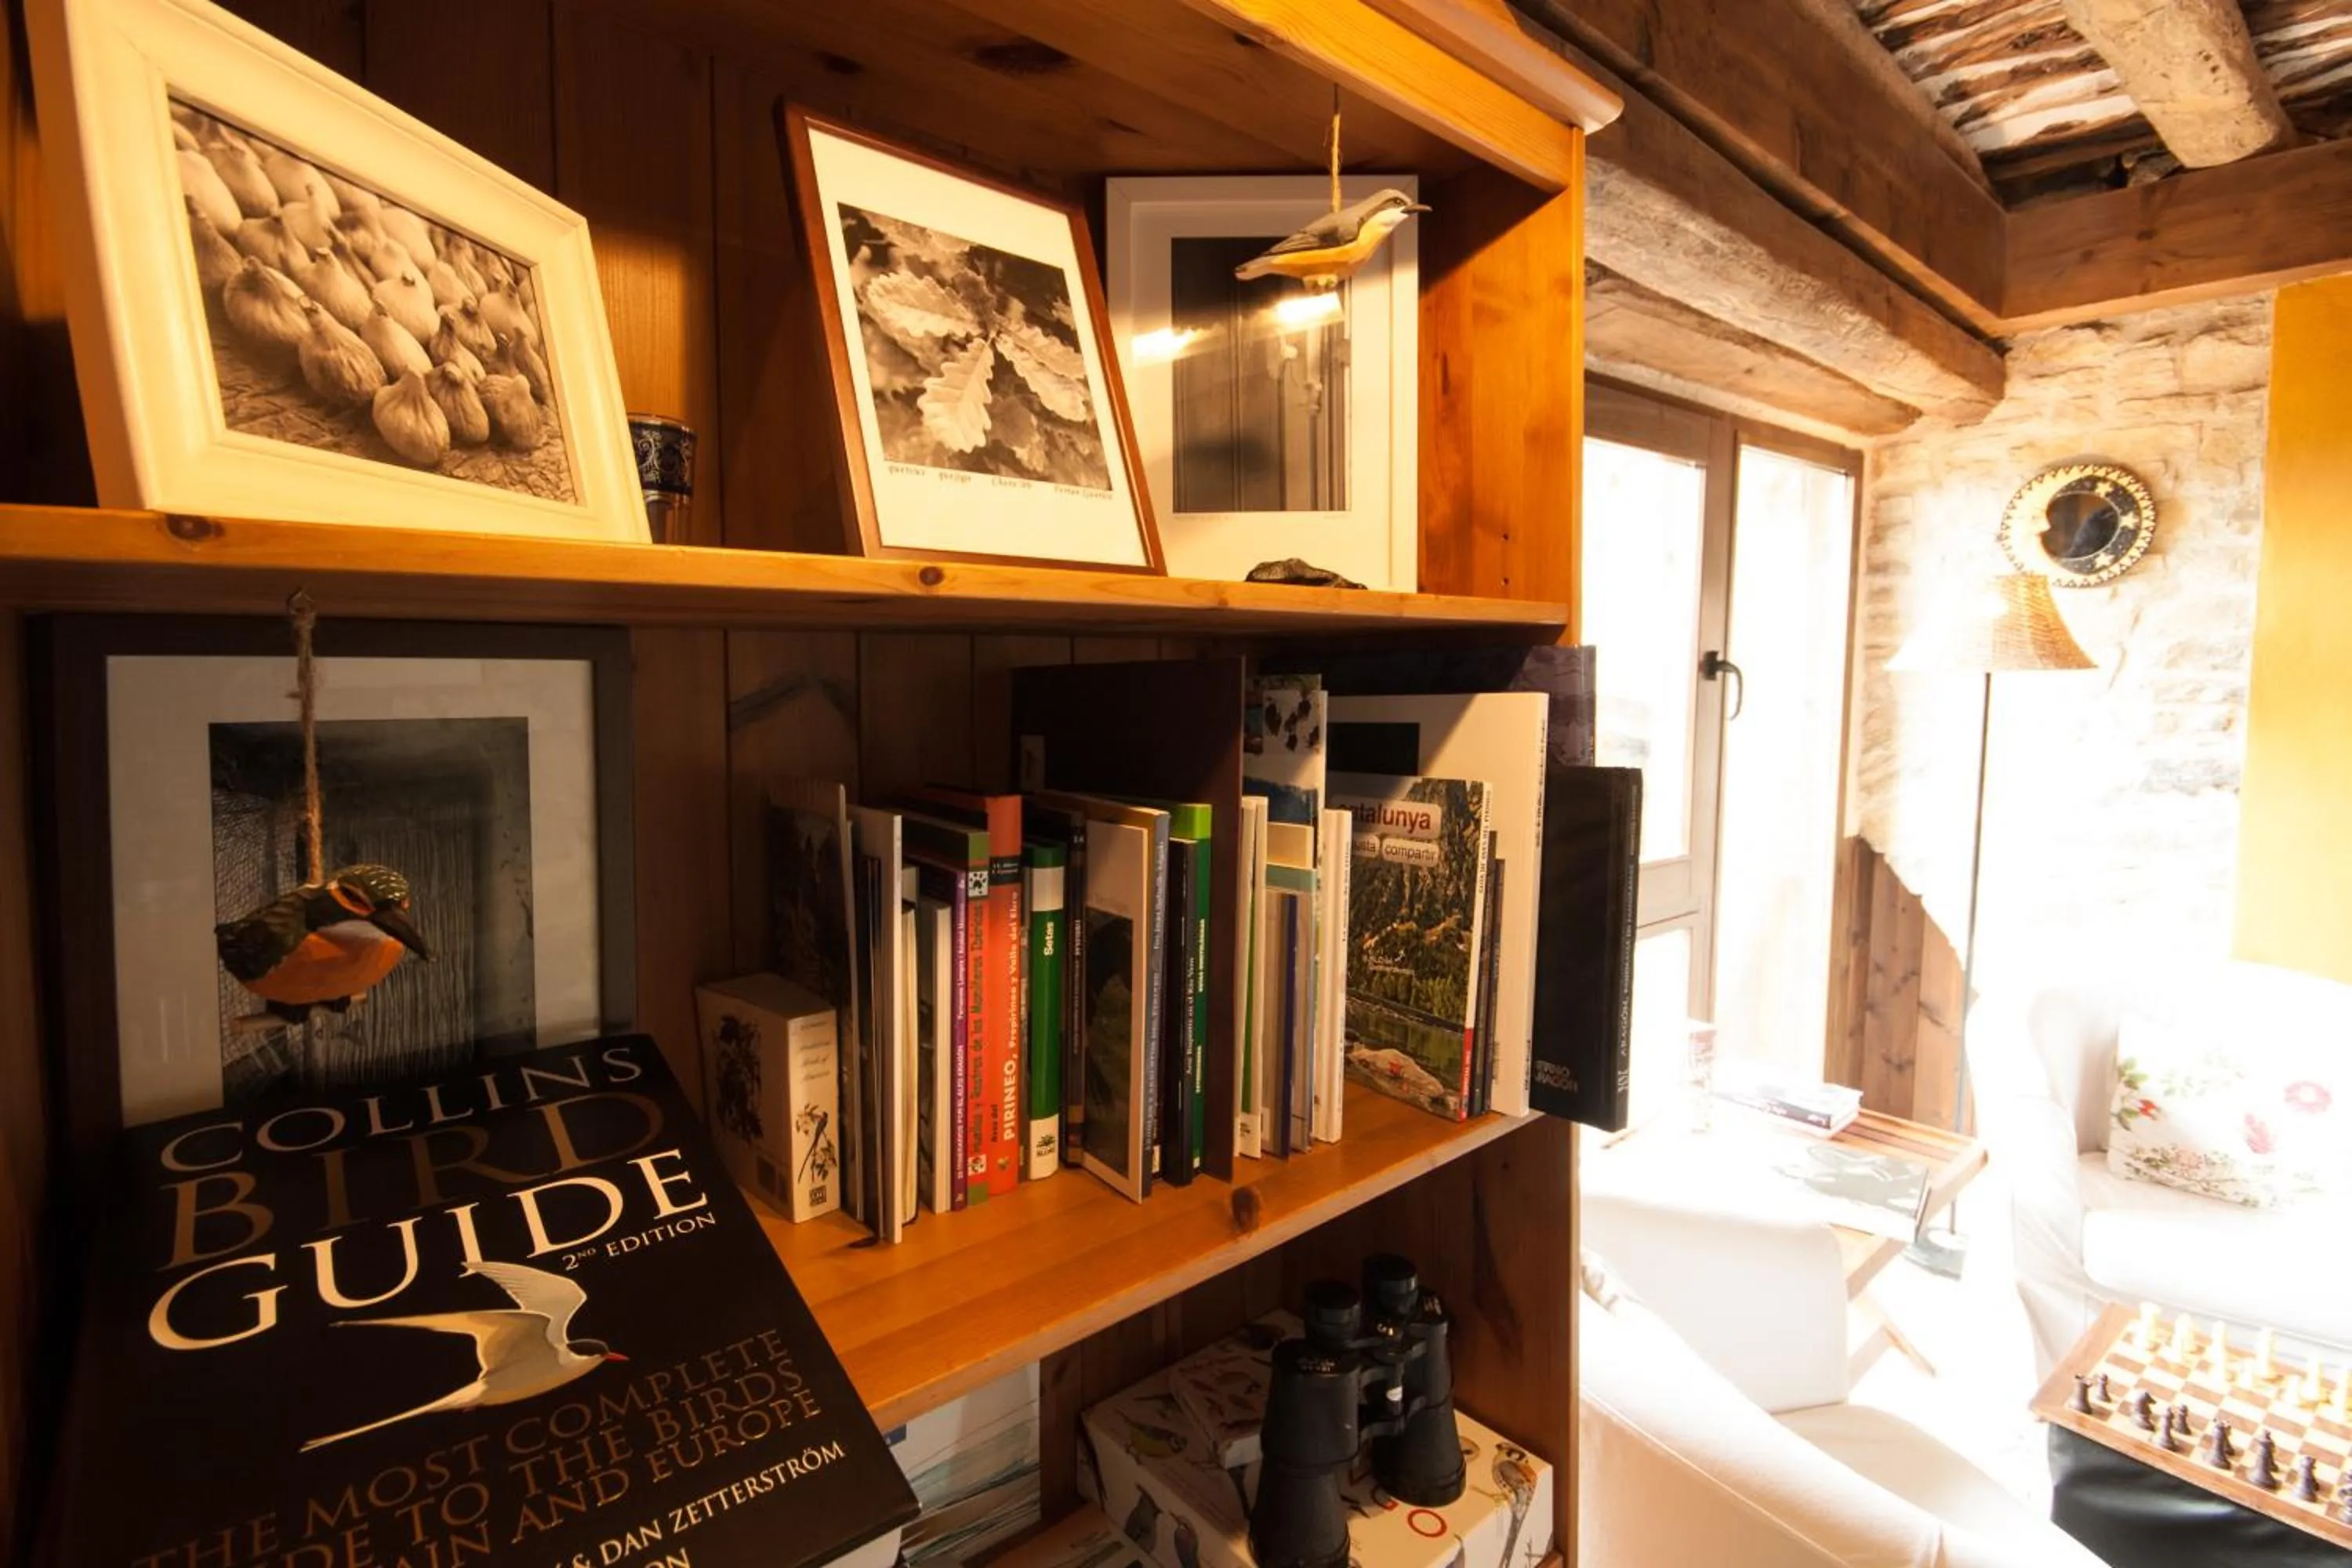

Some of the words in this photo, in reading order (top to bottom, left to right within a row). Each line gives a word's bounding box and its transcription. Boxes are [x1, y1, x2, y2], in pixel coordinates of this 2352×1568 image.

[1340, 802, 1431, 834] atalunya
[1044, 920, 1054, 956] Setas
[159, 1046, 644, 1174] COLLINS
[1004, 1053, 1018, 1141] PIRINEO,
[155, 1091, 666, 1272] BIRD
[604, 1210, 717, 1259] EDITION
[147, 1147, 708, 1351] GUIDE
[299, 1434, 490, 1540] MOST
[504, 1327, 788, 1455] COMPLETE
[394, 1481, 490, 1547] TO
[508, 1423, 634, 1500] THE
[645, 1358, 804, 1446] BIRDS
[510, 1468, 631, 1546] AND
[644, 1388, 822, 1484] EUROPE
[597, 1517, 664, 1568] DAN
[668, 1439, 848, 1535] ZETTERSTRÖM
